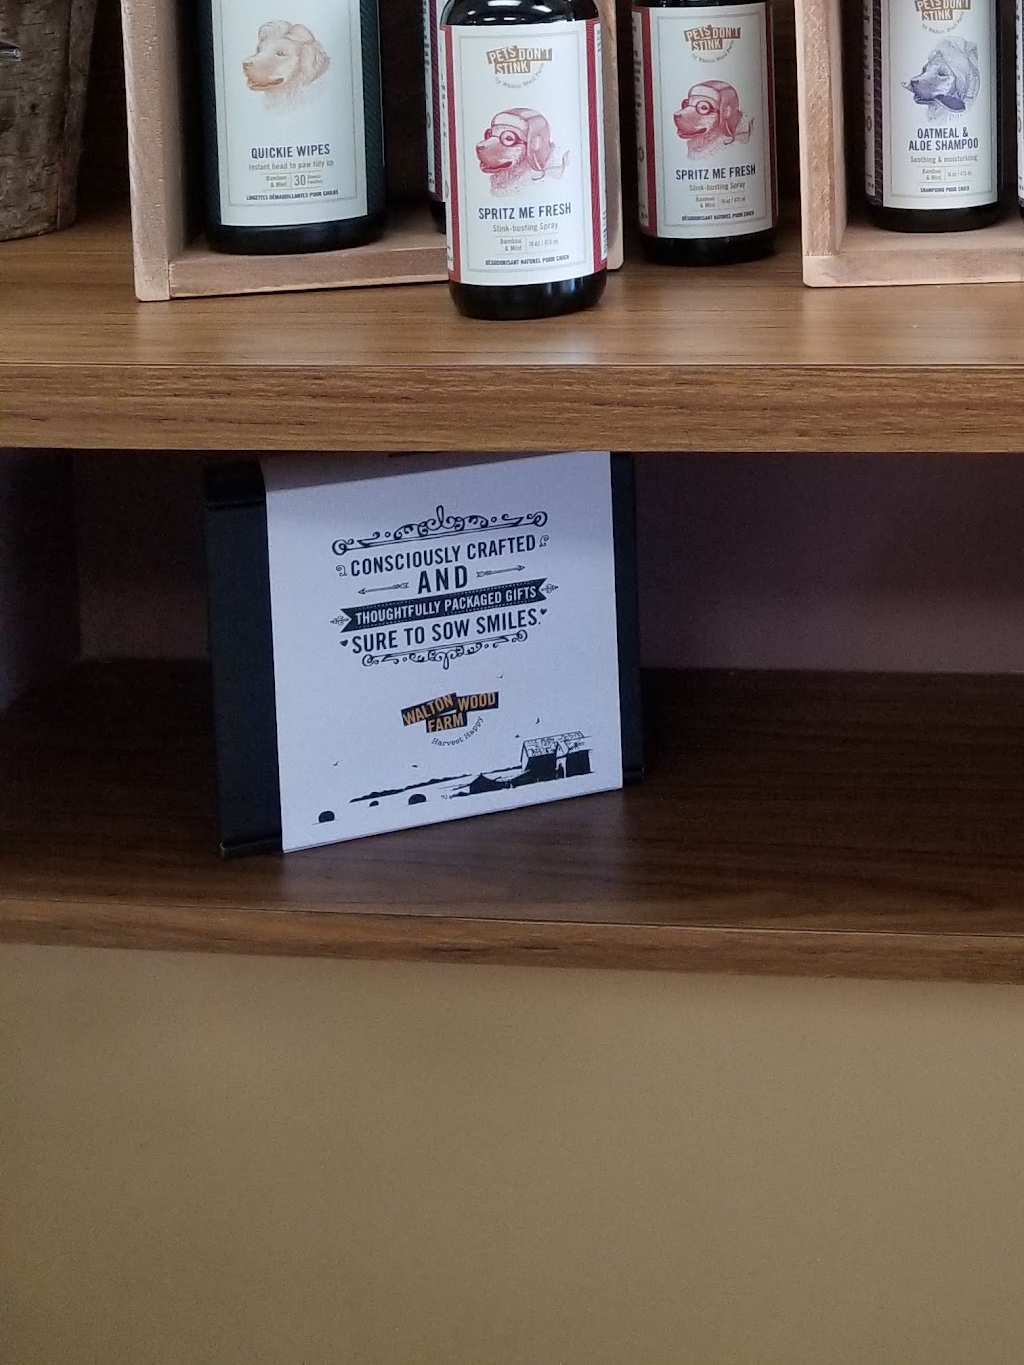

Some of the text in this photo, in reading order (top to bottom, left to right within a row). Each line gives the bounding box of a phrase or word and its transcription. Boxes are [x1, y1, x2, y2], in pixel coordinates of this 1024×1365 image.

[922, 9, 953, 21] STINK
[684, 25, 741, 41] PETS DON'T
[690, 38, 723, 50] STINK
[486, 46, 553, 64] PETS DON'T
[494, 61, 531, 74] STINK
[917, 126, 969, 139] OATMEAL &
[251, 143, 331, 159] QUICKIE WIPES
[908, 137, 979, 151] ALOE SHAMPOO
[272, 162, 288, 170] head
[312, 159, 325, 169] tidy
[326, 159, 335, 167] up
[676, 163, 756, 181] SPRITZ ME FRESH
[294, 174, 306, 186] 30
[478, 202, 572, 220] SPRITZ ME FRESH
[492, 222, 559, 233] Stink-busting Spray
[350, 534, 536, 577] CONSCIOUSLY CRAFTED
[417, 565, 469, 594] AND
[355, 585, 537, 626] THOUGHTFULLY PACKAGED GIFTS
[351, 608, 542, 654] SURE TO SOW SMILES.
[402, 692, 497, 726] WALTON WOOD
[427, 713, 464, 732] FARM
[431, 715, 484, 747] Harvest Happy
